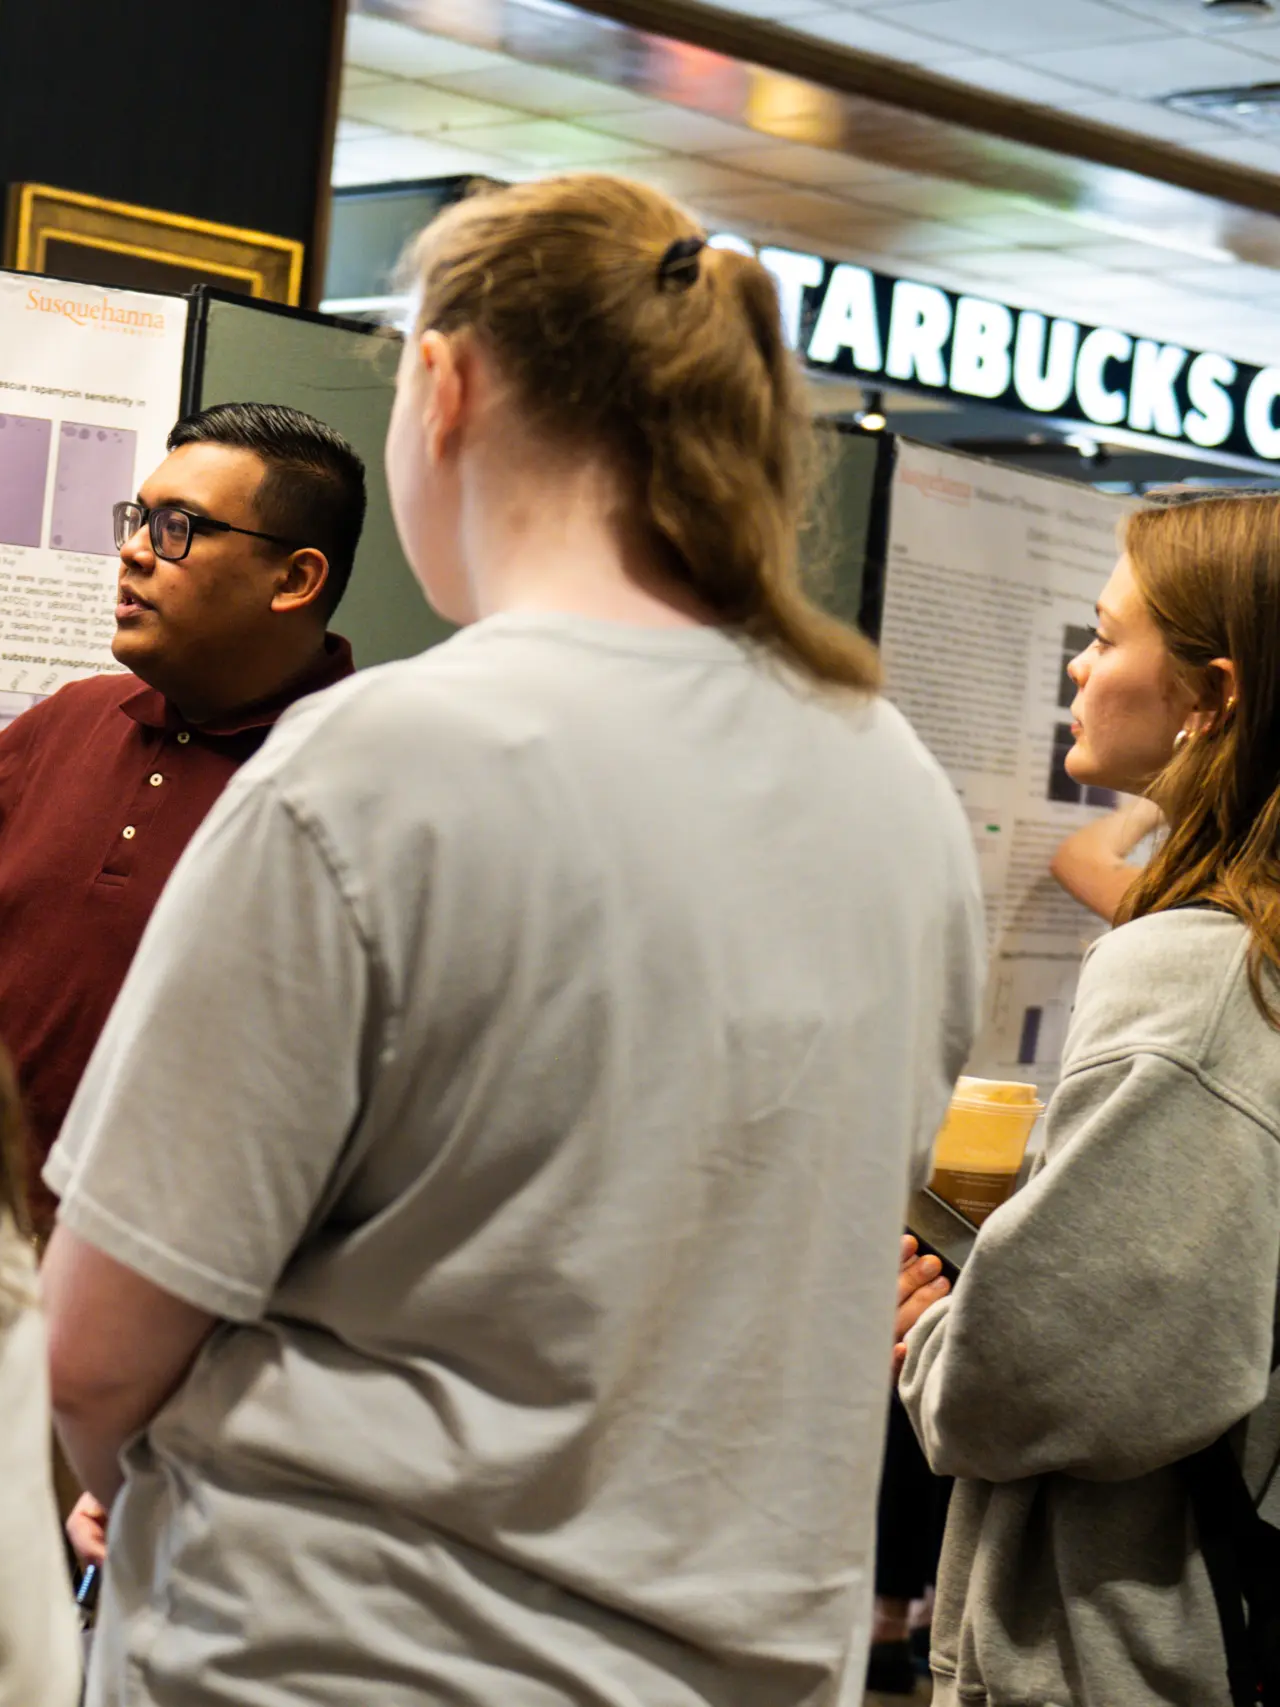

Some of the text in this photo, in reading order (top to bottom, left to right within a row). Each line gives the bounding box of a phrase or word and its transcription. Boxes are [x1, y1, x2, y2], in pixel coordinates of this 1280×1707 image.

[26, 288, 164, 329] Susquehanna
[707, 234, 1236, 447] TARBUCKS
[30, 385, 82, 398] rapamycin
[84, 392, 133, 407] sensitivity
[1, 653, 47, 664] substrate
